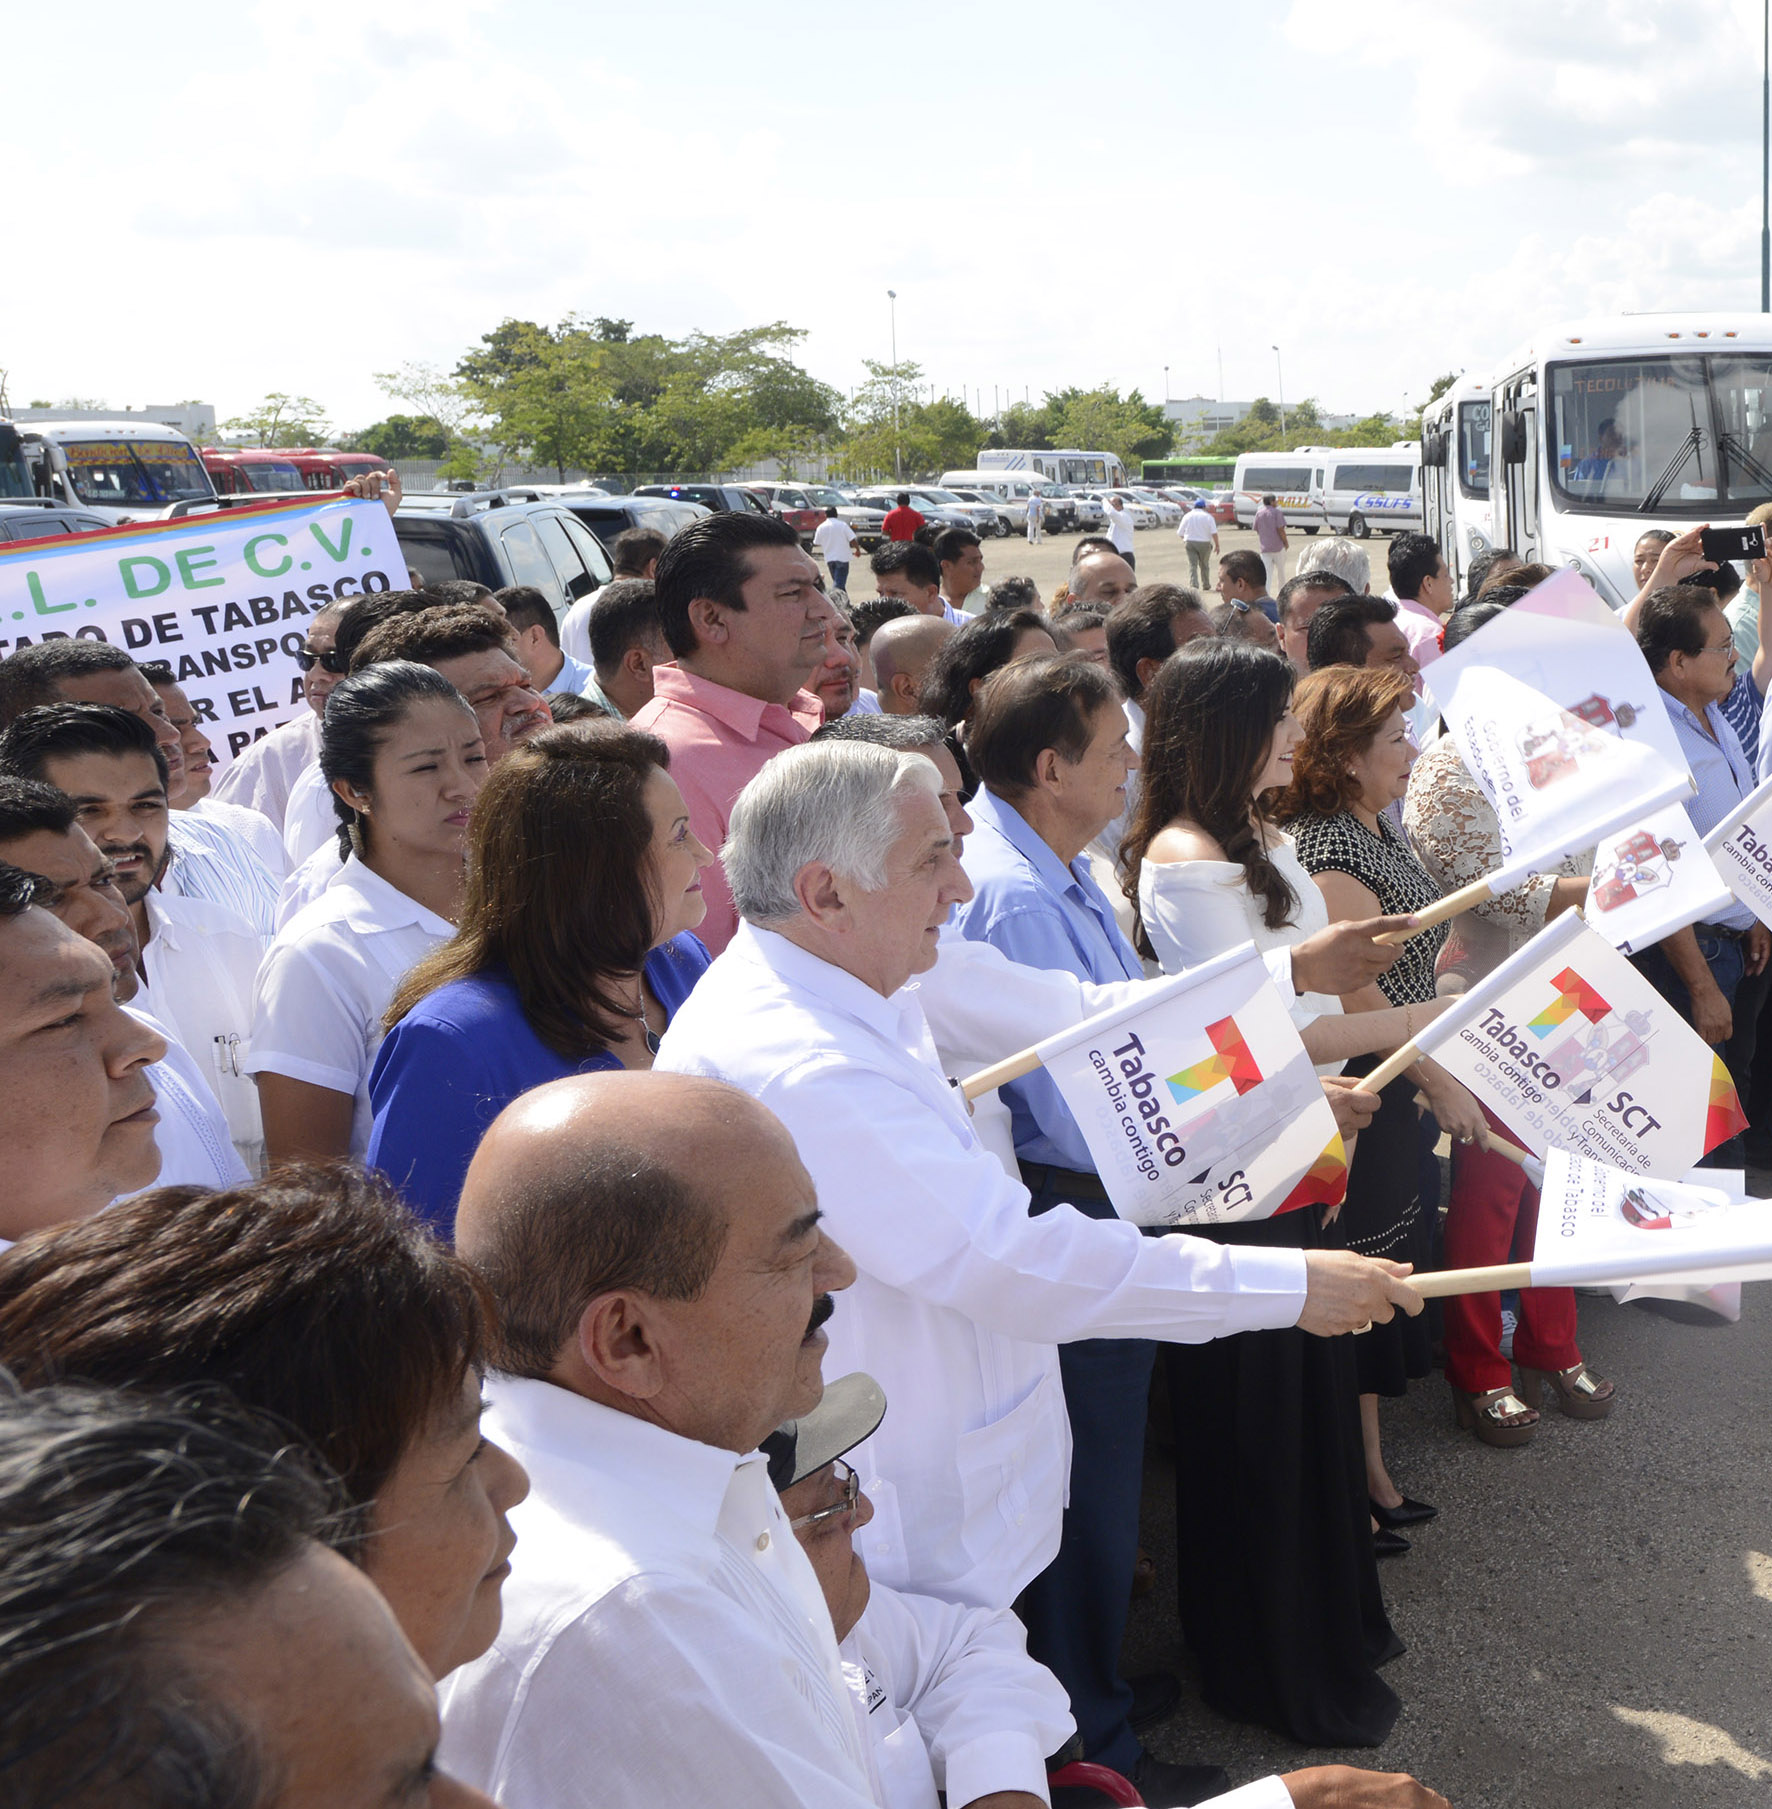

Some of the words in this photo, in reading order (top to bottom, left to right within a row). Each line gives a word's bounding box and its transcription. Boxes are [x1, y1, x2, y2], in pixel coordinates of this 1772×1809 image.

[118, 545, 226, 599] DE
[243, 517, 373, 579] C.V.
[1588, 536, 1610, 552] 21
[121, 611, 184, 650] DE
[191, 570, 390, 636] TABASCO
[227, 685, 279, 718] EL
[1722, 841, 1756, 875] cambia
[1459, 1028, 1500, 1063] cambia
[1497, 1060, 1542, 1104] contigo
[1478, 1008, 1561, 1090] Tabasco
[1088, 1049, 1127, 1114] cambia
[1121, 1116, 1160, 1182] contigo
[1113, 1032, 1185, 1167] Tabasco
[1606, 1091, 1662, 1139] SCT
[1593, 1109, 1638, 1156] Secretaría
[1636, 1155, 1651, 1169] de
[1218, 1170, 1253, 1211] SCT
